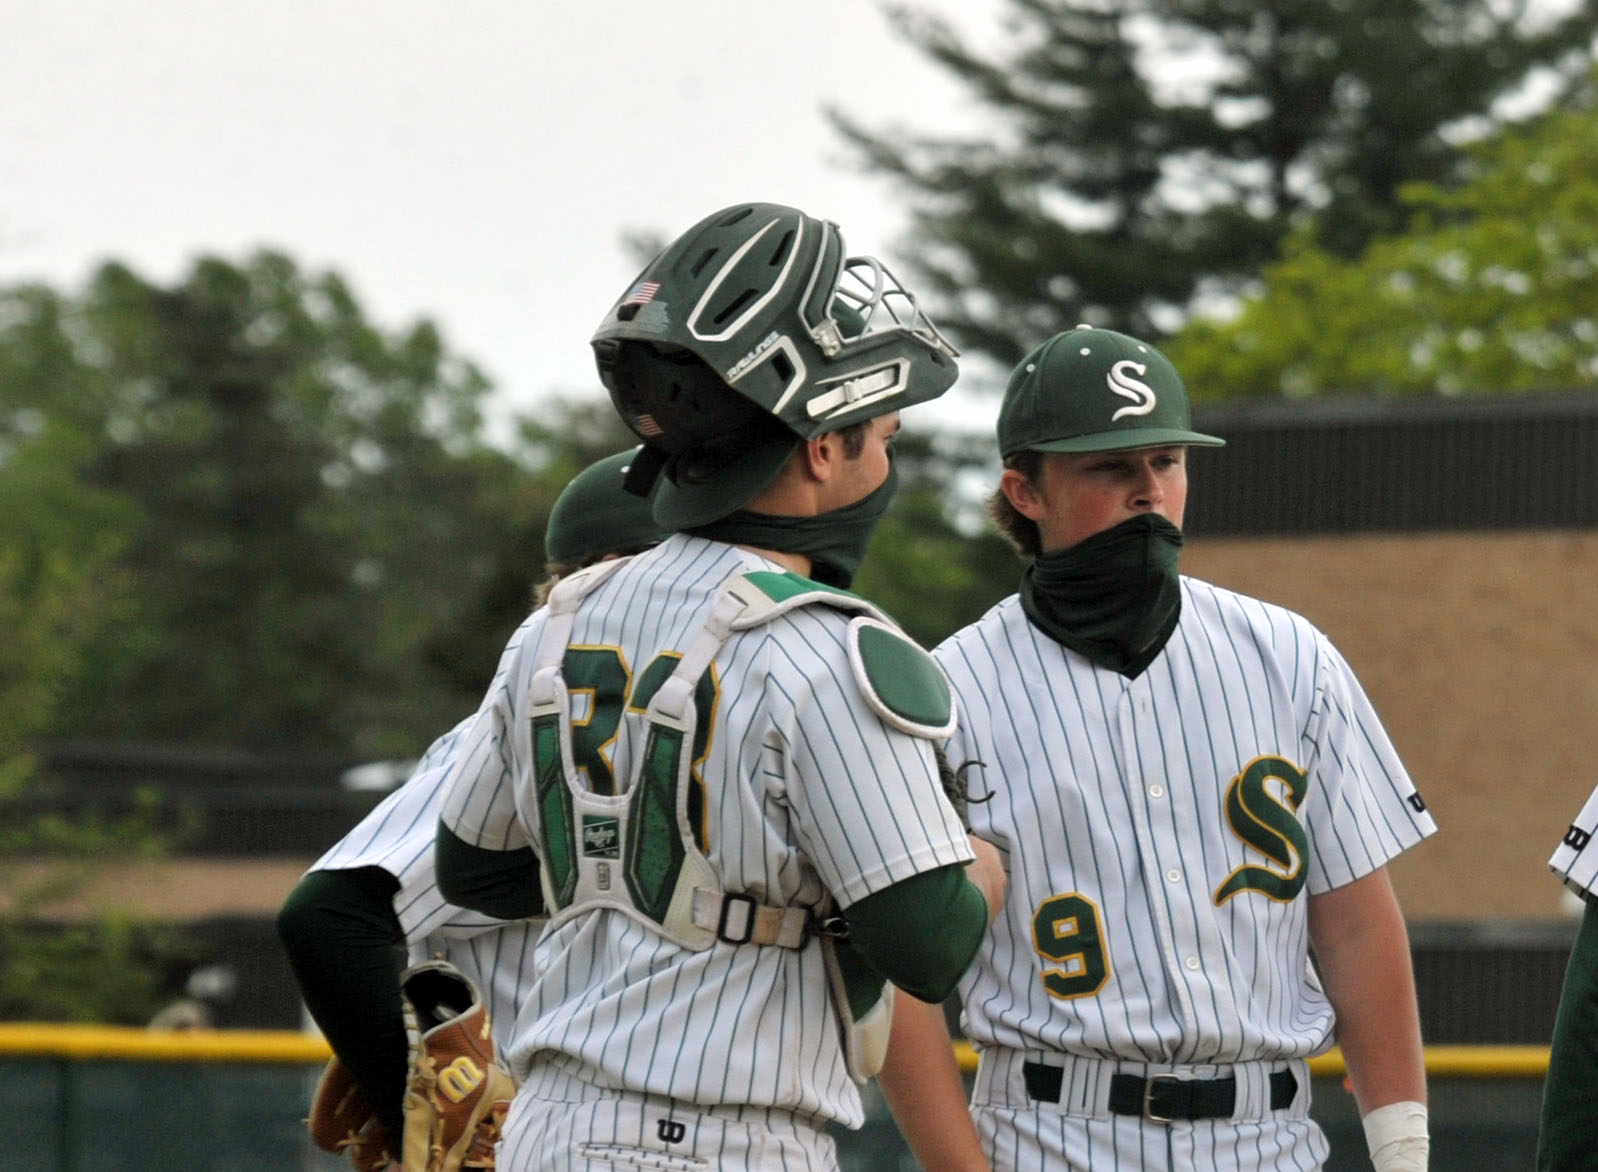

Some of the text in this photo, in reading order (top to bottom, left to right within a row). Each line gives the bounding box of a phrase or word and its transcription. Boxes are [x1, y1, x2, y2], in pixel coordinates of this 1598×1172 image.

[1106, 359, 1156, 422] S
[1213, 754, 1309, 908] S
[1031, 891, 1111, 1001] 9
